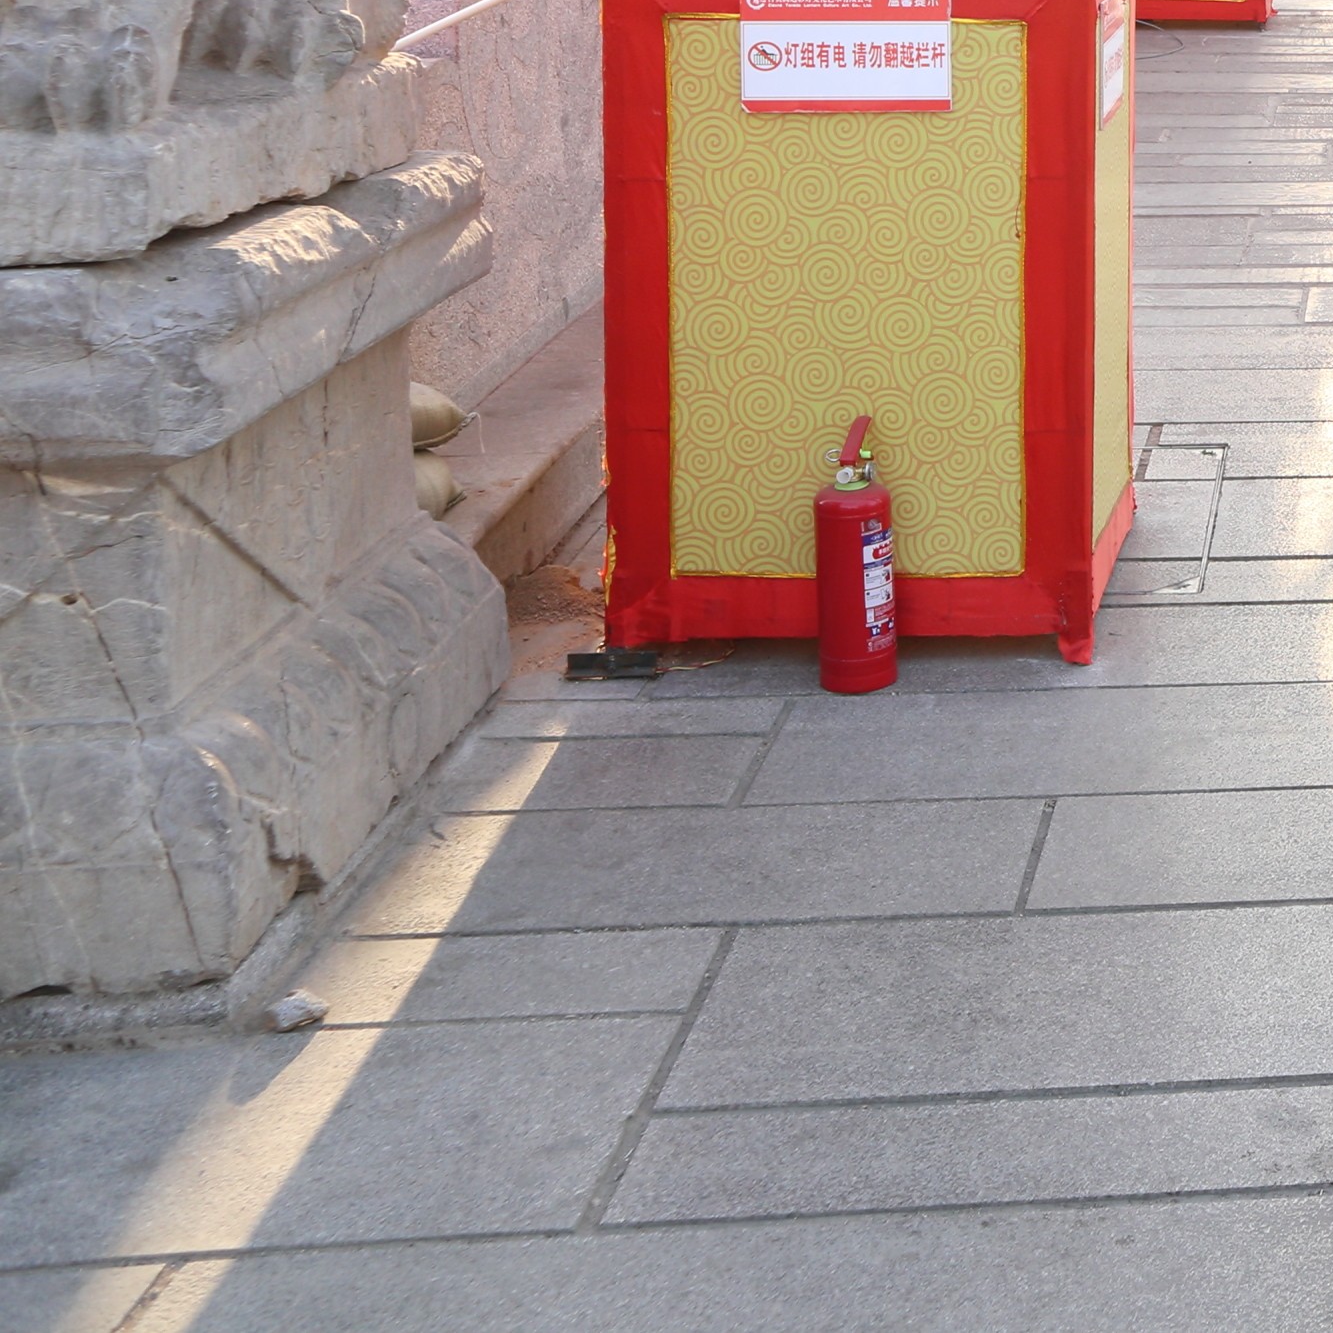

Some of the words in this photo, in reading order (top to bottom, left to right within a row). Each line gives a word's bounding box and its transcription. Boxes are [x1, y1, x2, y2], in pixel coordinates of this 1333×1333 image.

[784, 41, 847, 69] 灯组有电
[852, 41, 946, 69] 请勿翻越栏杆
